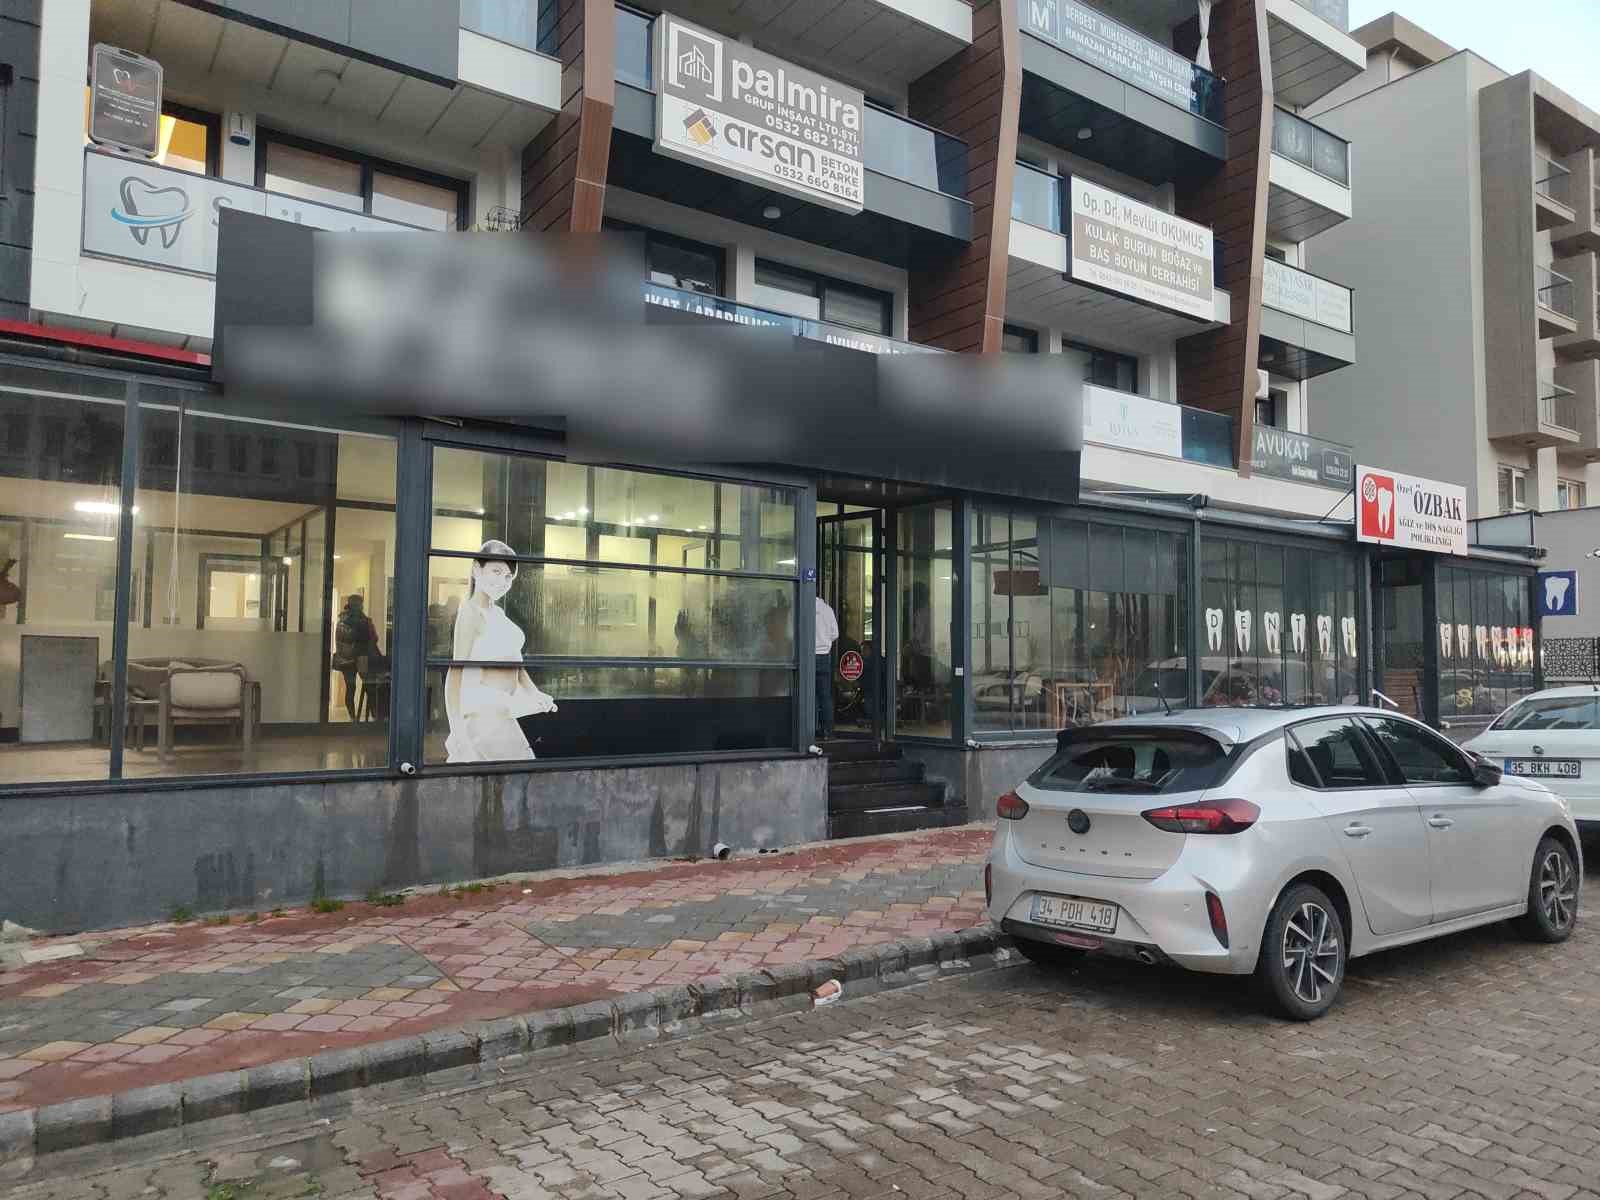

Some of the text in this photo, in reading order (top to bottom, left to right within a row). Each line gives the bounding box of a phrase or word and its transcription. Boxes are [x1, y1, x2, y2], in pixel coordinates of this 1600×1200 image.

[732, 58, 859, 131] palmira
[744, 94, 774, 114] GRUP
[777, 103, 816, 126] İNŞAAT
[724, 121, 816, 172] arsan
[766, 114, 859, 156] 0532 682 1231
[774, 164, 859, 200] 0532 660 8164
[821, 155, 859, 177] BETON
[821, 168, 859, 188] PARKE
[1083, 191, 1101, 214] Op.
[1085, 222, 1203, 275] KULAK BURUN BOĞAZ ve
[1089, 245, 1111, 265] BAŞ
[1114, 253, 1148, 275] BOYUN
[1151, 264, 1200, 292] CERRAHİSİ
[1256, 431, 1310, 461] AVUKAT
[1414, 484, 1462, 521] ÖZBAK
[1511, 761, 1579, 774] 35 BKH 408
[1040, 899, 1053, 915] 34
[1091, 905, 1113, 925] 418
